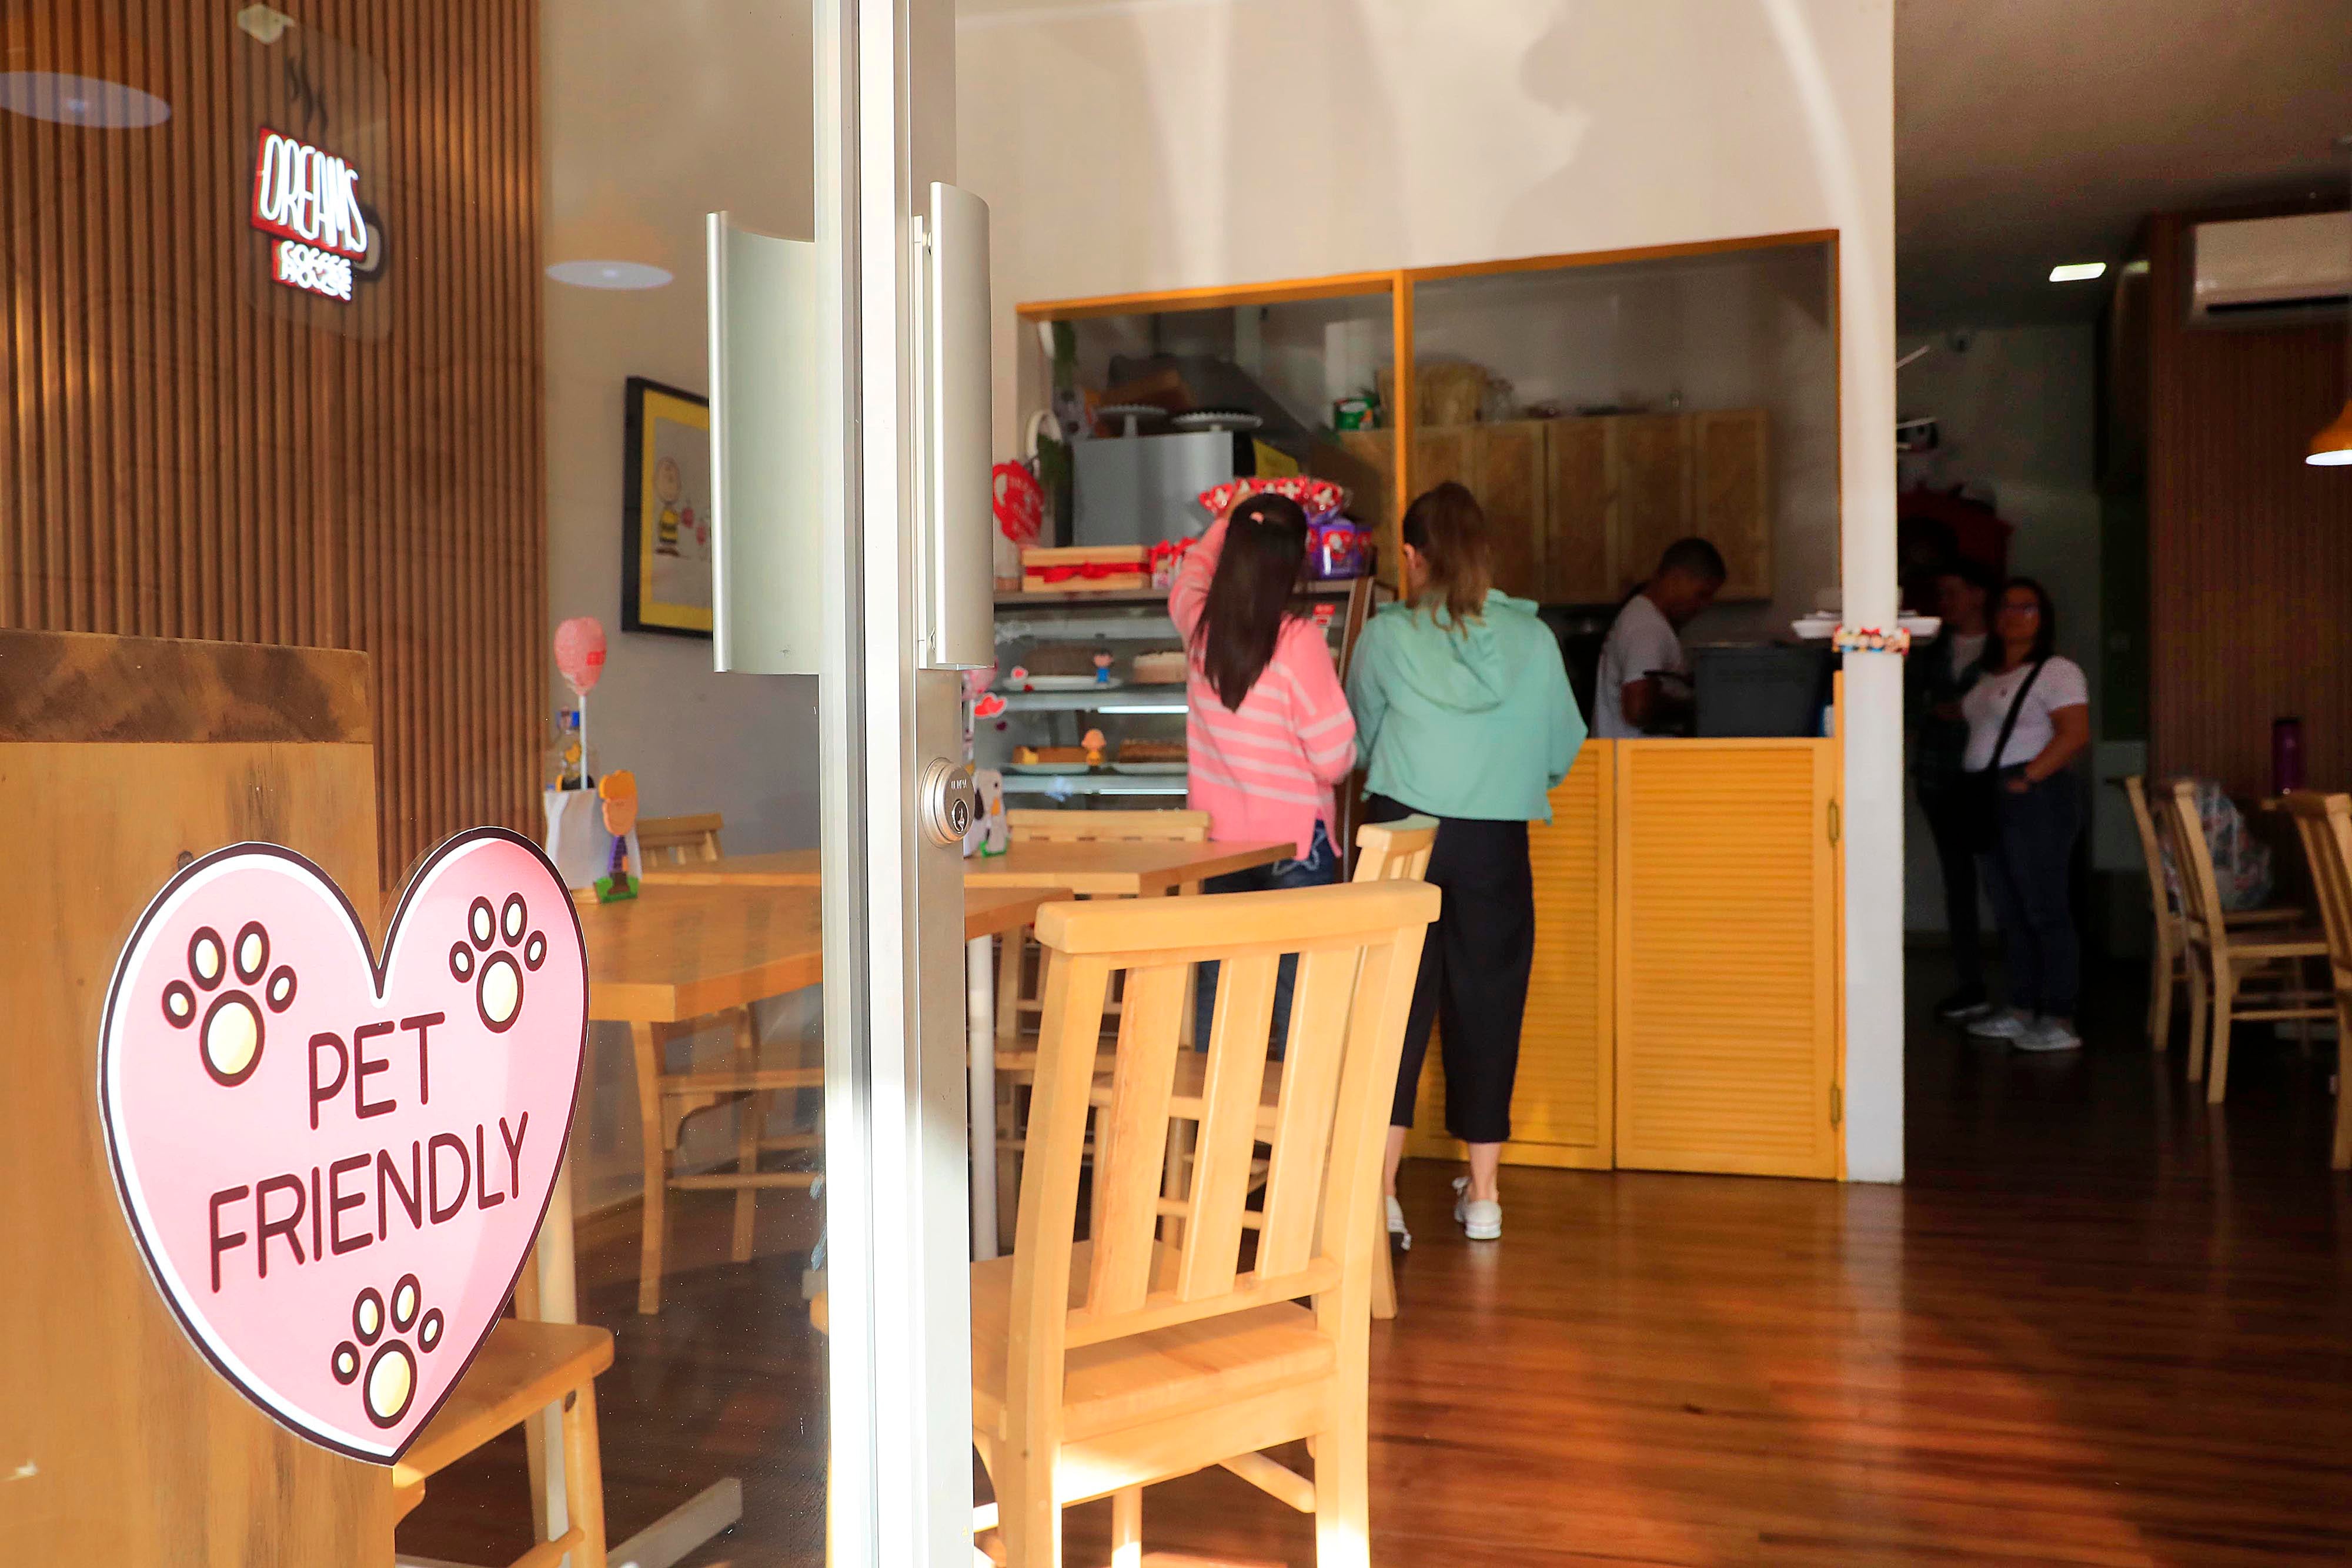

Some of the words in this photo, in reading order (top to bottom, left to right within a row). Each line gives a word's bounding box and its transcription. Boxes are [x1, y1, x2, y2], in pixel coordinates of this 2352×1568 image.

[259, 133, 368, 253] DREAMS
[308, 1011, 446, 1131] PET
[209, 1111, 529, 1293] FRIENDLY
